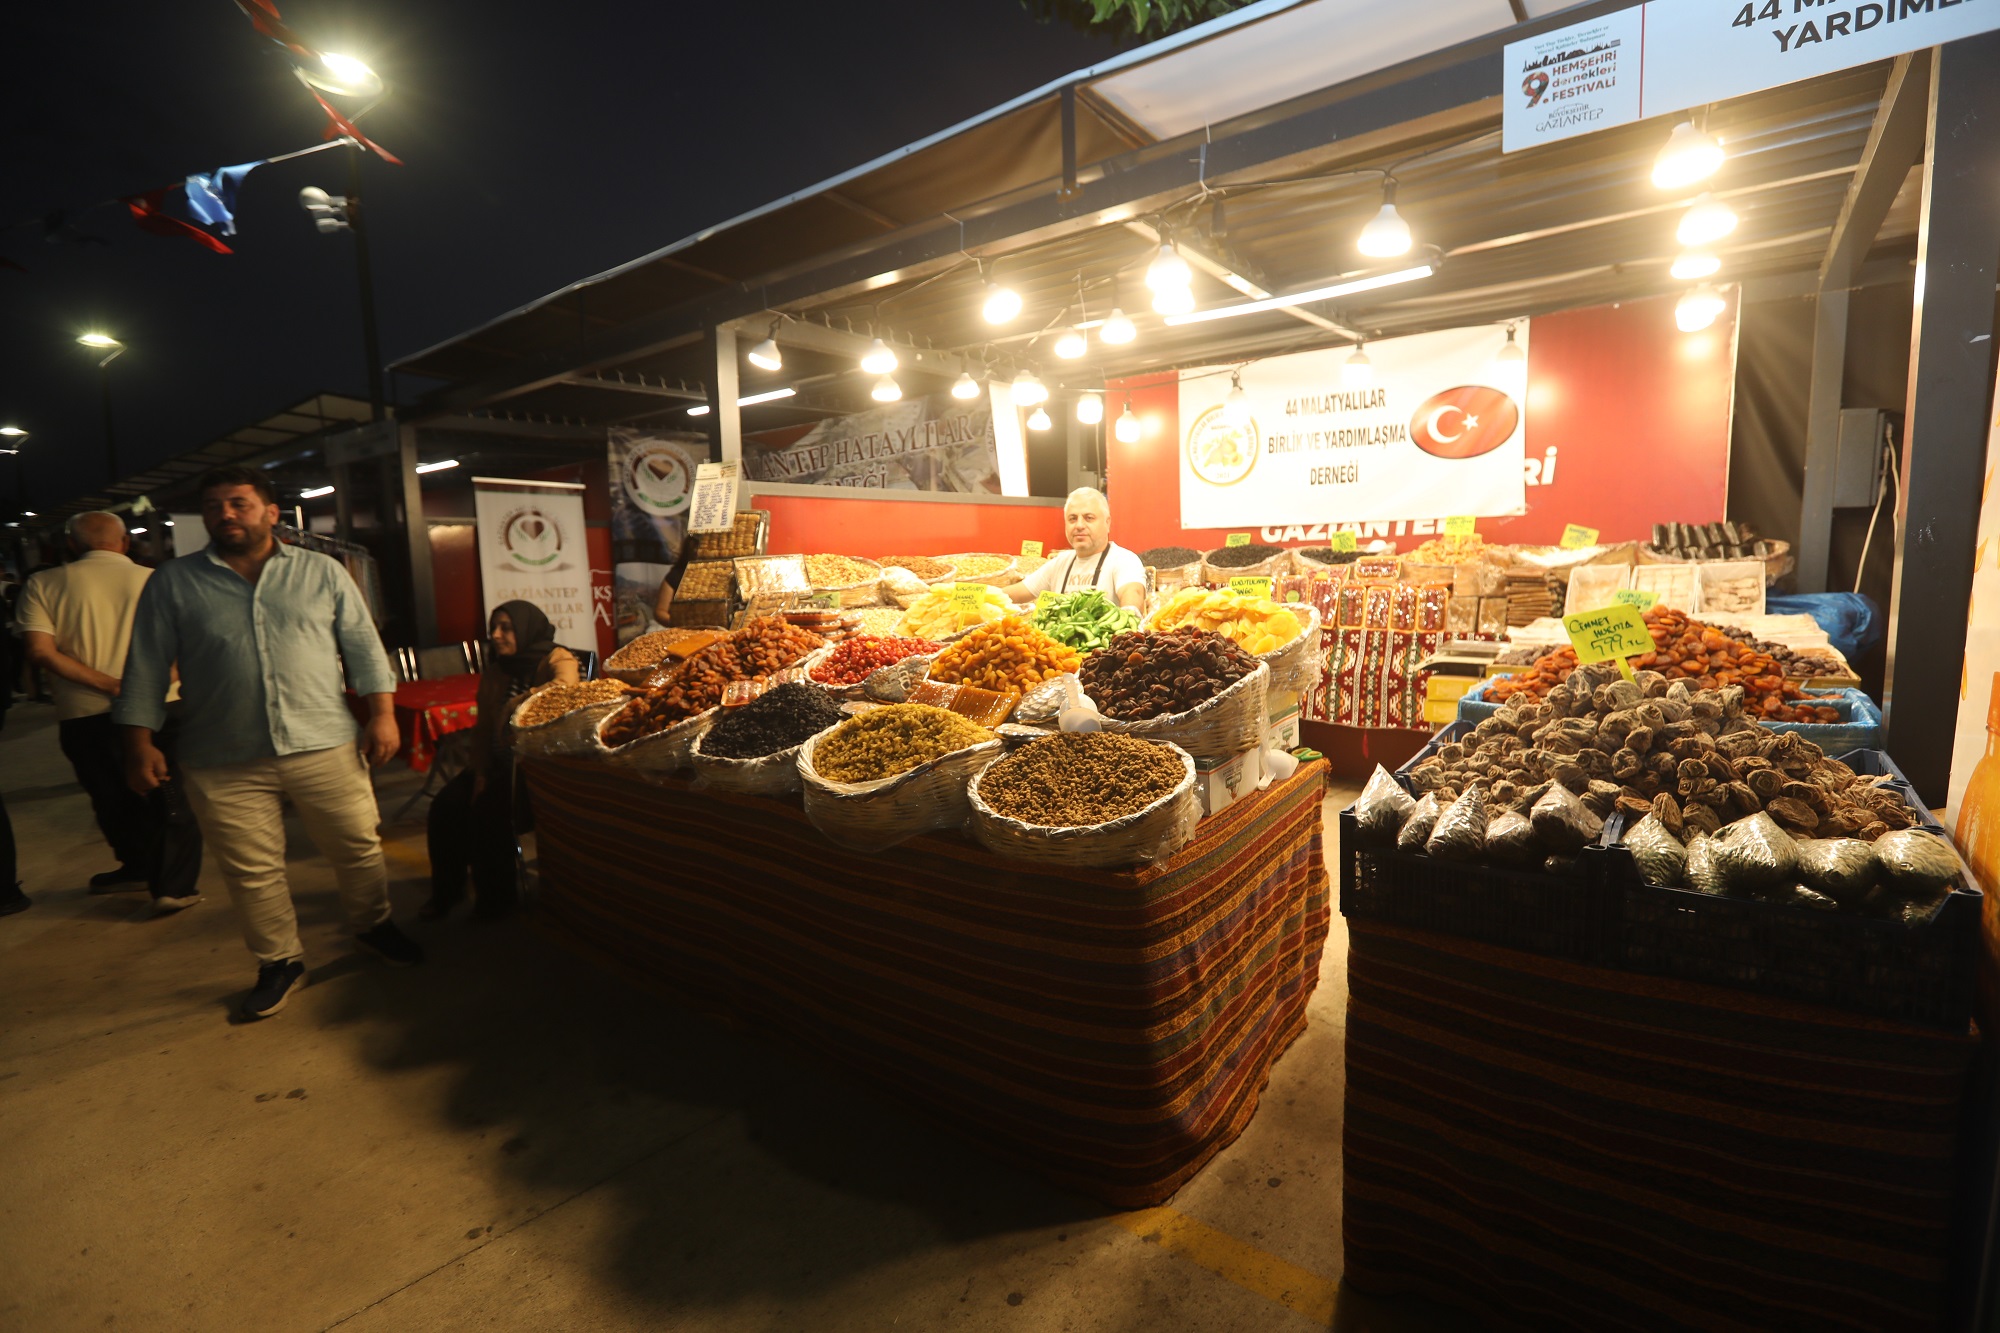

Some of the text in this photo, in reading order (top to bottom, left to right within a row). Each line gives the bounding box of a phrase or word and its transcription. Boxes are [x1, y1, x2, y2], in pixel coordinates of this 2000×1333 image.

[1731, 0, 1782, 28] 44
[1772, 0, 1976, 53] YARDIM
[1552, 50, 1617, 76] HEMŞEHRİ
[1552, 62, 1617, 88] dernekleri
[1552, 76, 1616, 102] FESTİVALİ
[1286, 388, 1386, 417] 44 MALATYALILAR
[835, 414, 974, 465] HATAYLILAR
[1268, 430, 1303, 454] BİRLİK
[1306, 432, 1321, 451] VE
[1324, 423, 1407, 450] YARDIMLAŞMA
[1310, 459, 1359, 485] DERNEĞİ
[1261, 519, 1446, 543] GAZANTE
